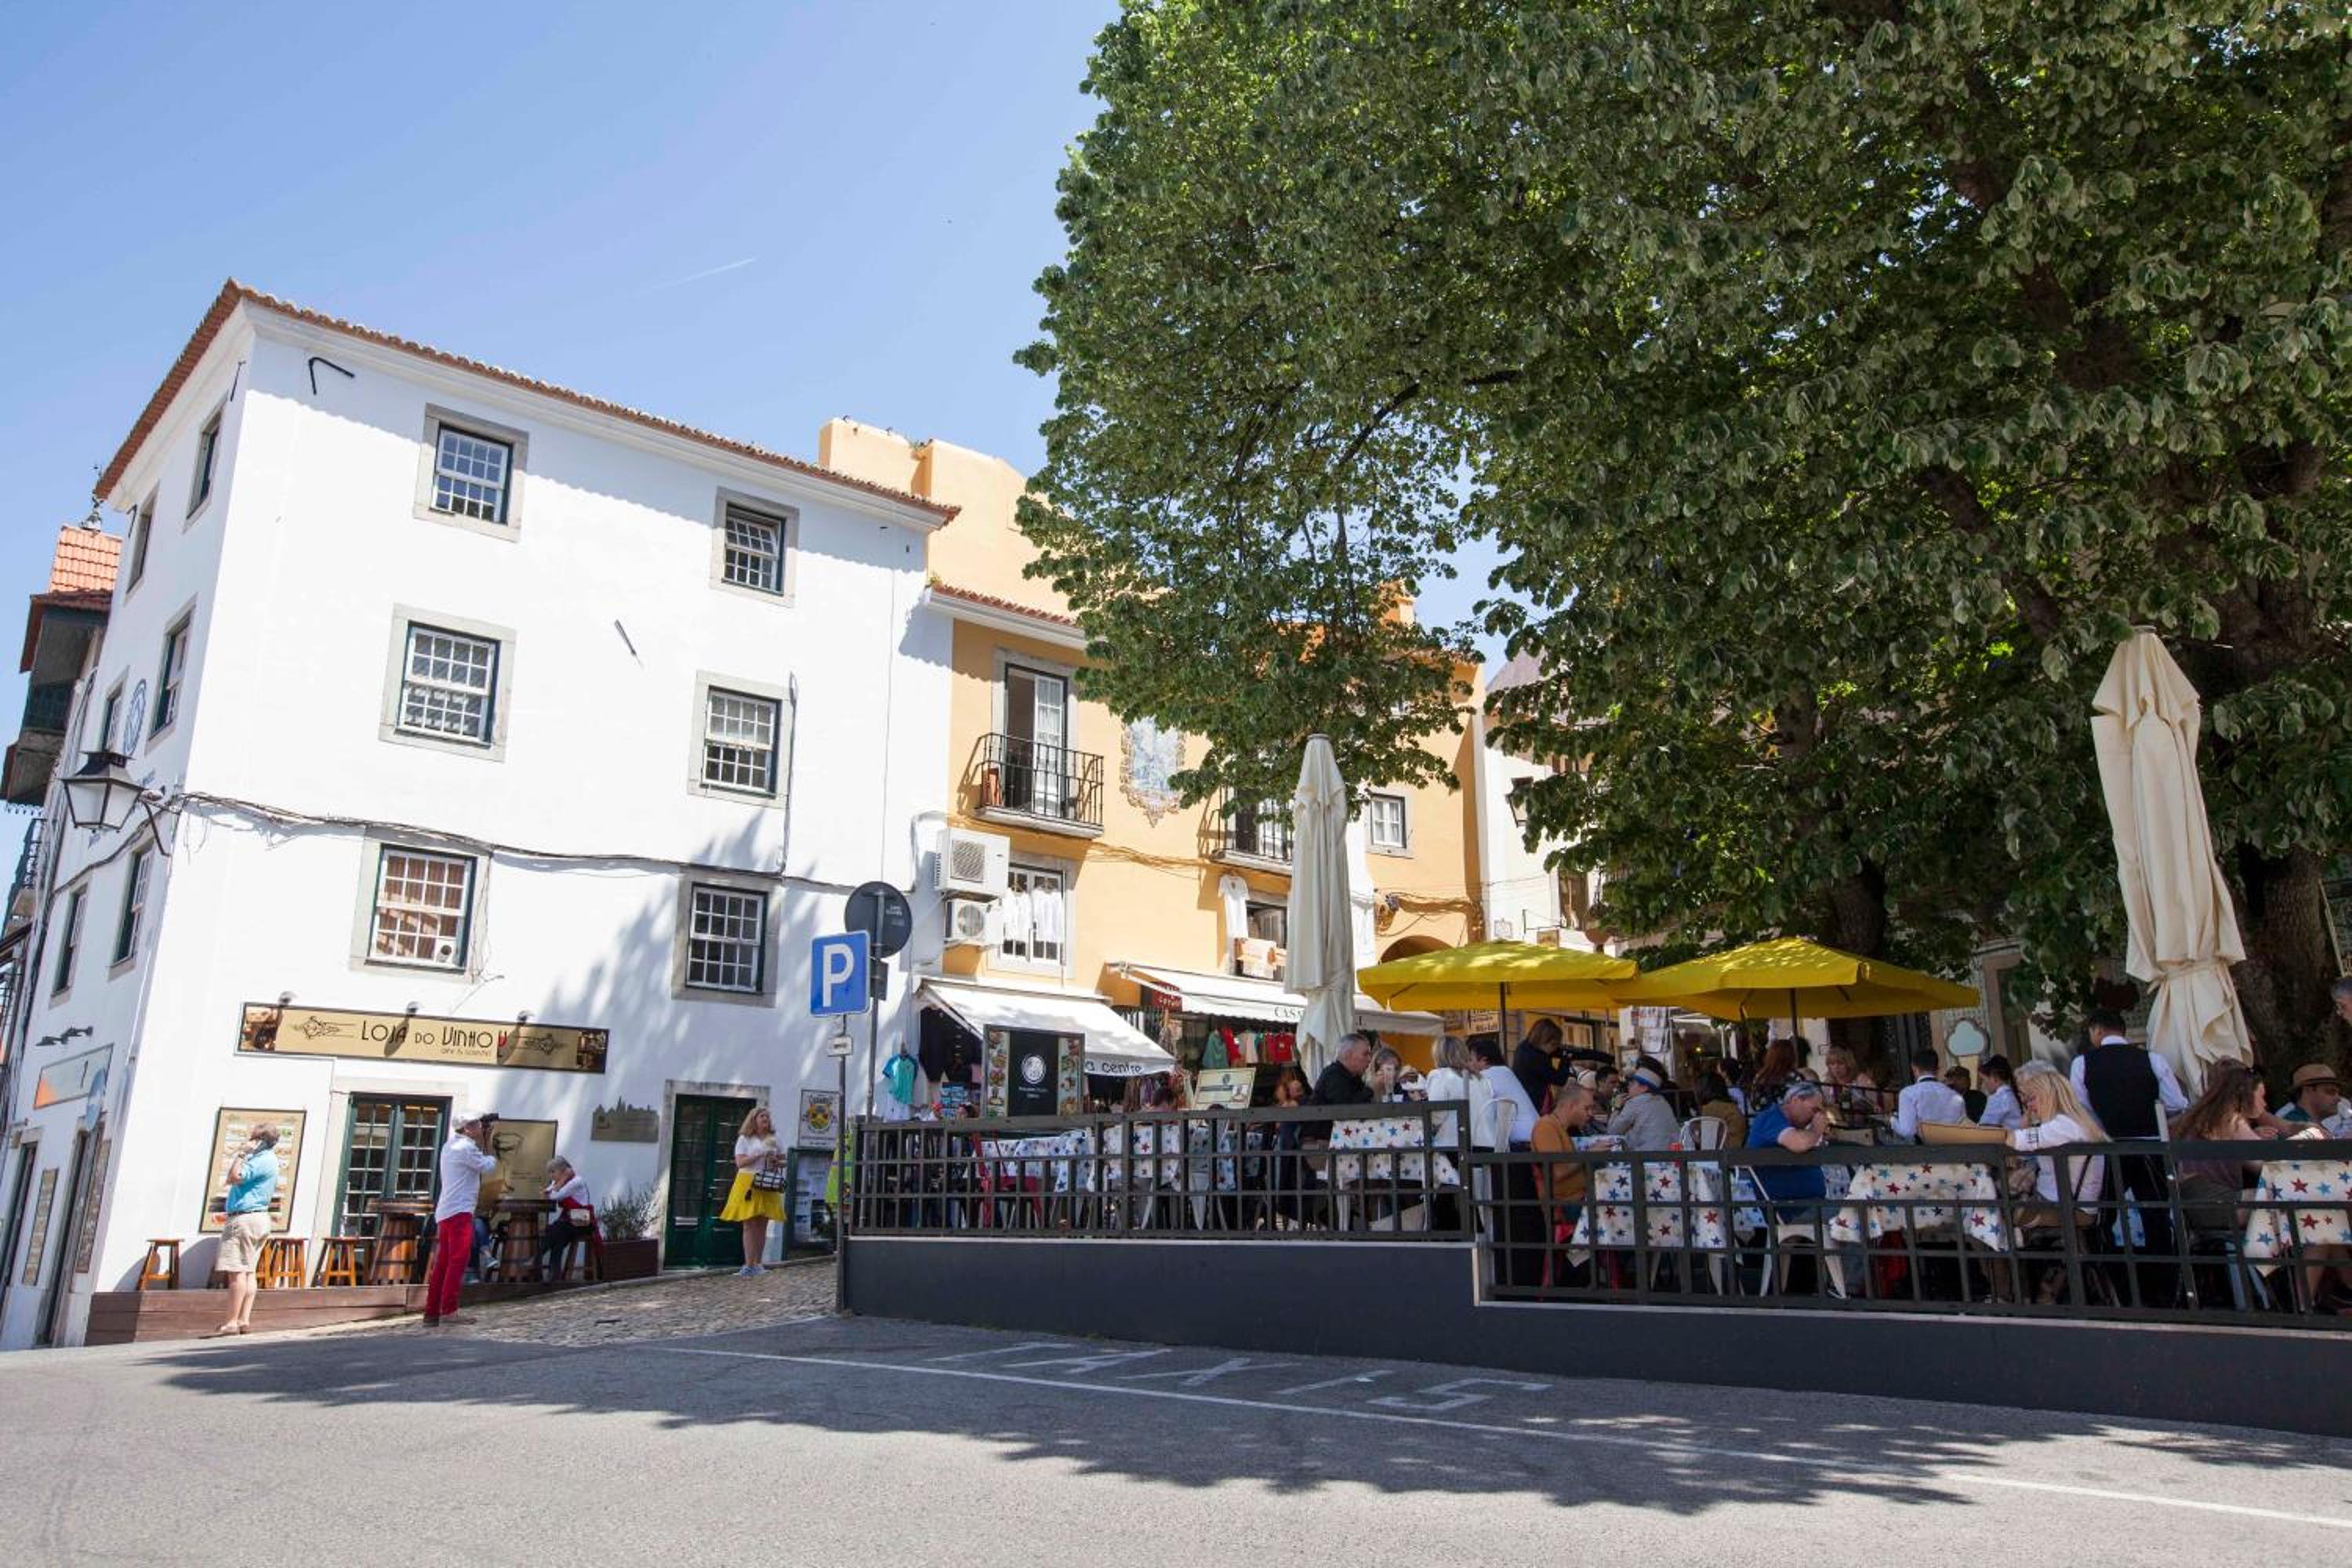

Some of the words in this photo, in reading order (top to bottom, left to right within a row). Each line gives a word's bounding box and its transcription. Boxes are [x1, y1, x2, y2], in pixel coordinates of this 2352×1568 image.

[822, 943, 855, 1007] P
[361, 1020, 407, 1043] LOJA
[415, 1031, 435, 1045] DO
[442, 1025, 493, 1048] VINHO
[924, 1341, 1554, 1410] TAXIS
